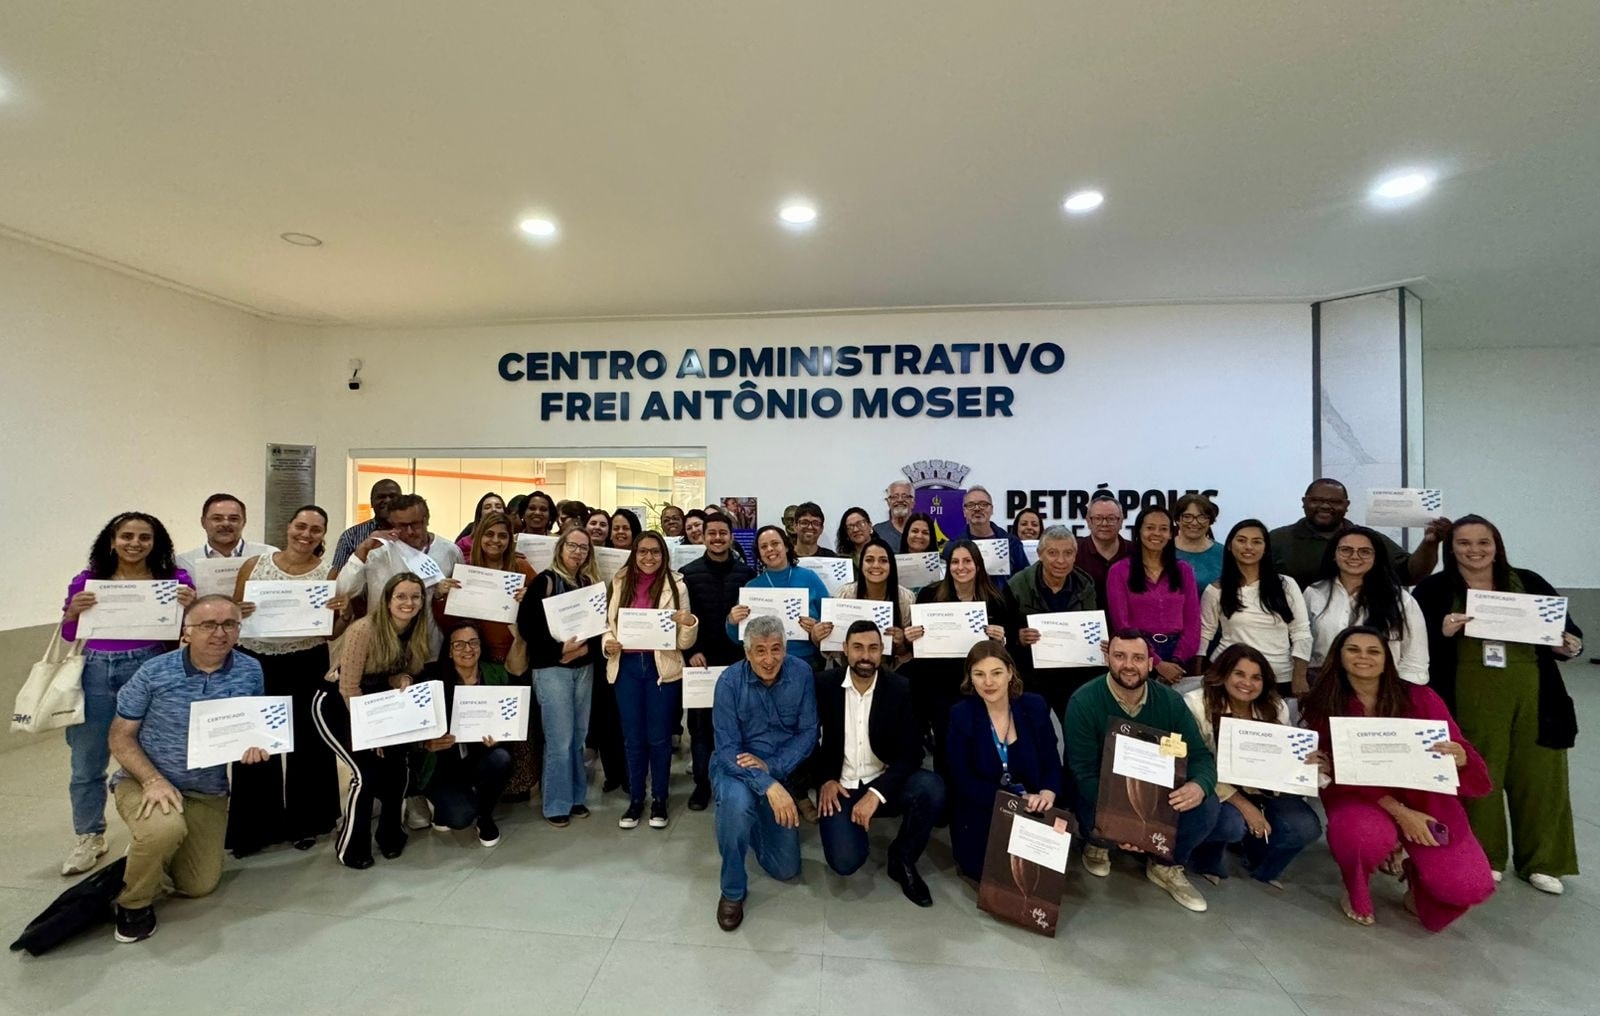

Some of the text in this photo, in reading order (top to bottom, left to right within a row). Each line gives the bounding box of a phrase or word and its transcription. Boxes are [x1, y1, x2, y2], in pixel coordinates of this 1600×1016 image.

[498, 342, 1065, 381] CENTRO ADMINISTRATIVO
[541, 379, 1015, 421] FREI ANTÔNIO MOSER
